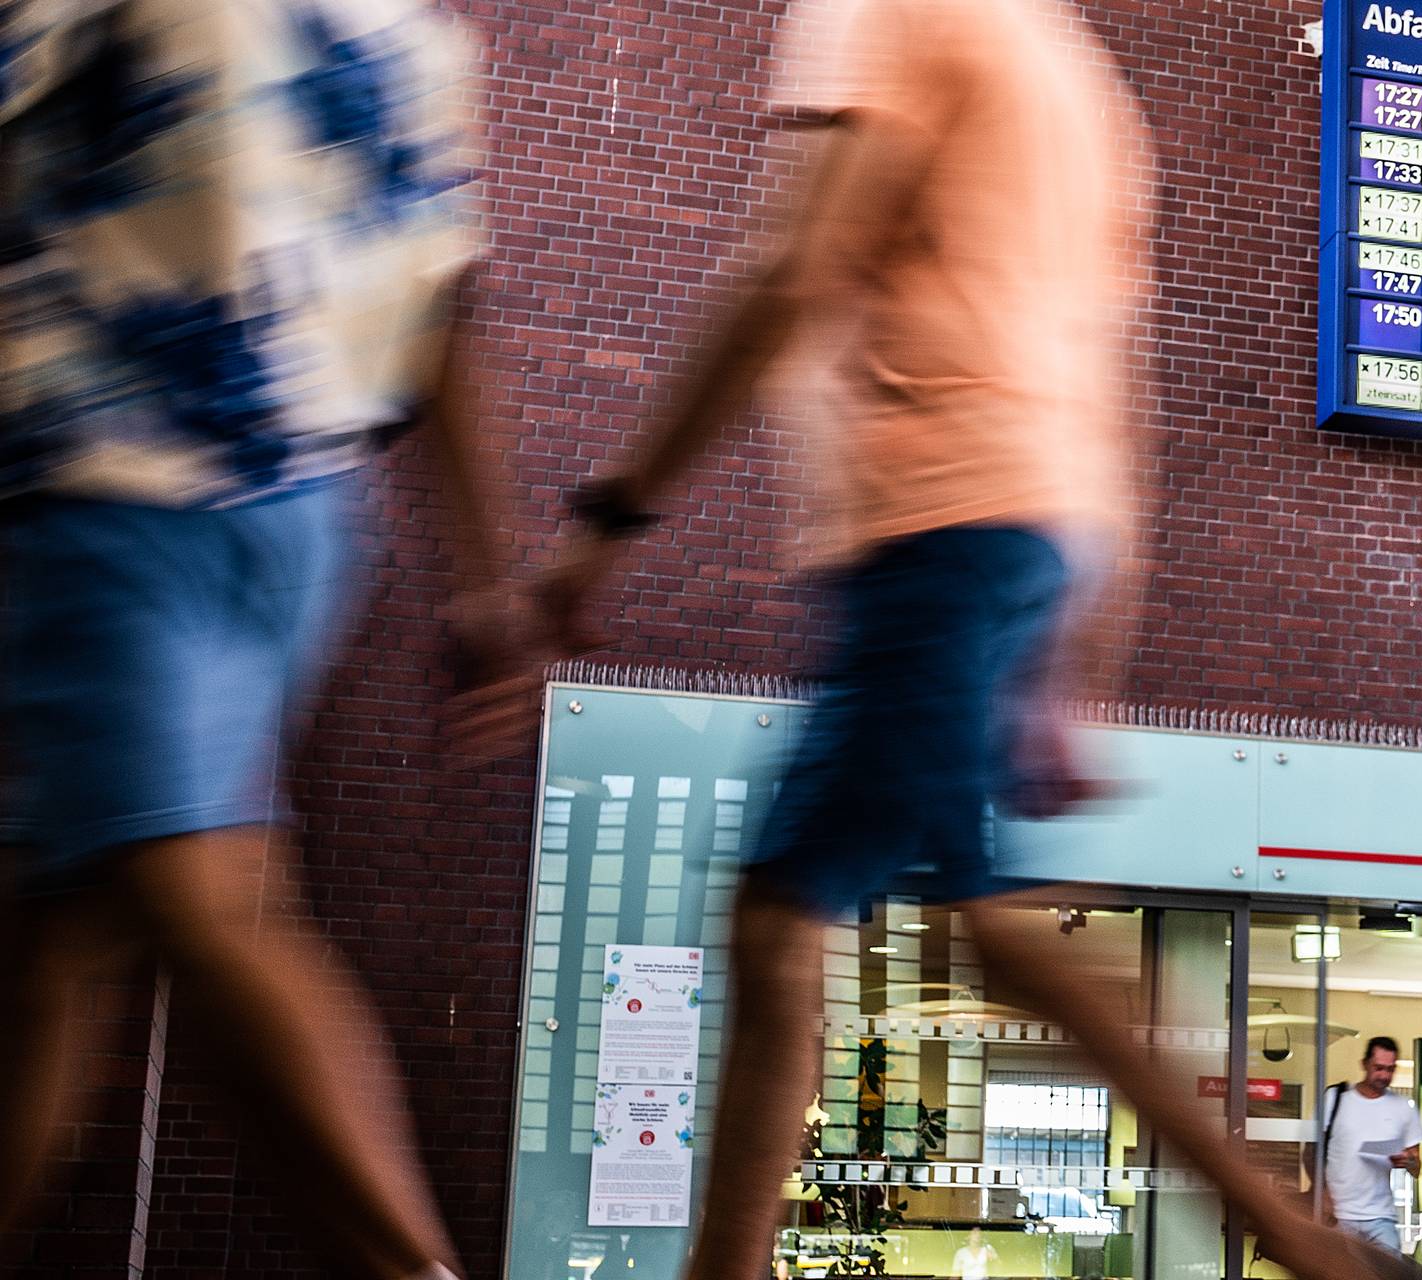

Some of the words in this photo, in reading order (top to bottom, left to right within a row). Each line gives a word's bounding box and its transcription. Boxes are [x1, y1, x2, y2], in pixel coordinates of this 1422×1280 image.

[1366, 54, 1390, 70] Zeit
[1373, 105, 1422, 129] 17:27
[1373, 160, 1422, 184] 17:33
[1372, 271, 1422, 295] 17:47
[1372, 303, 1422, 328] 17:50
[1374, 361, 1420, 382] 17:56
